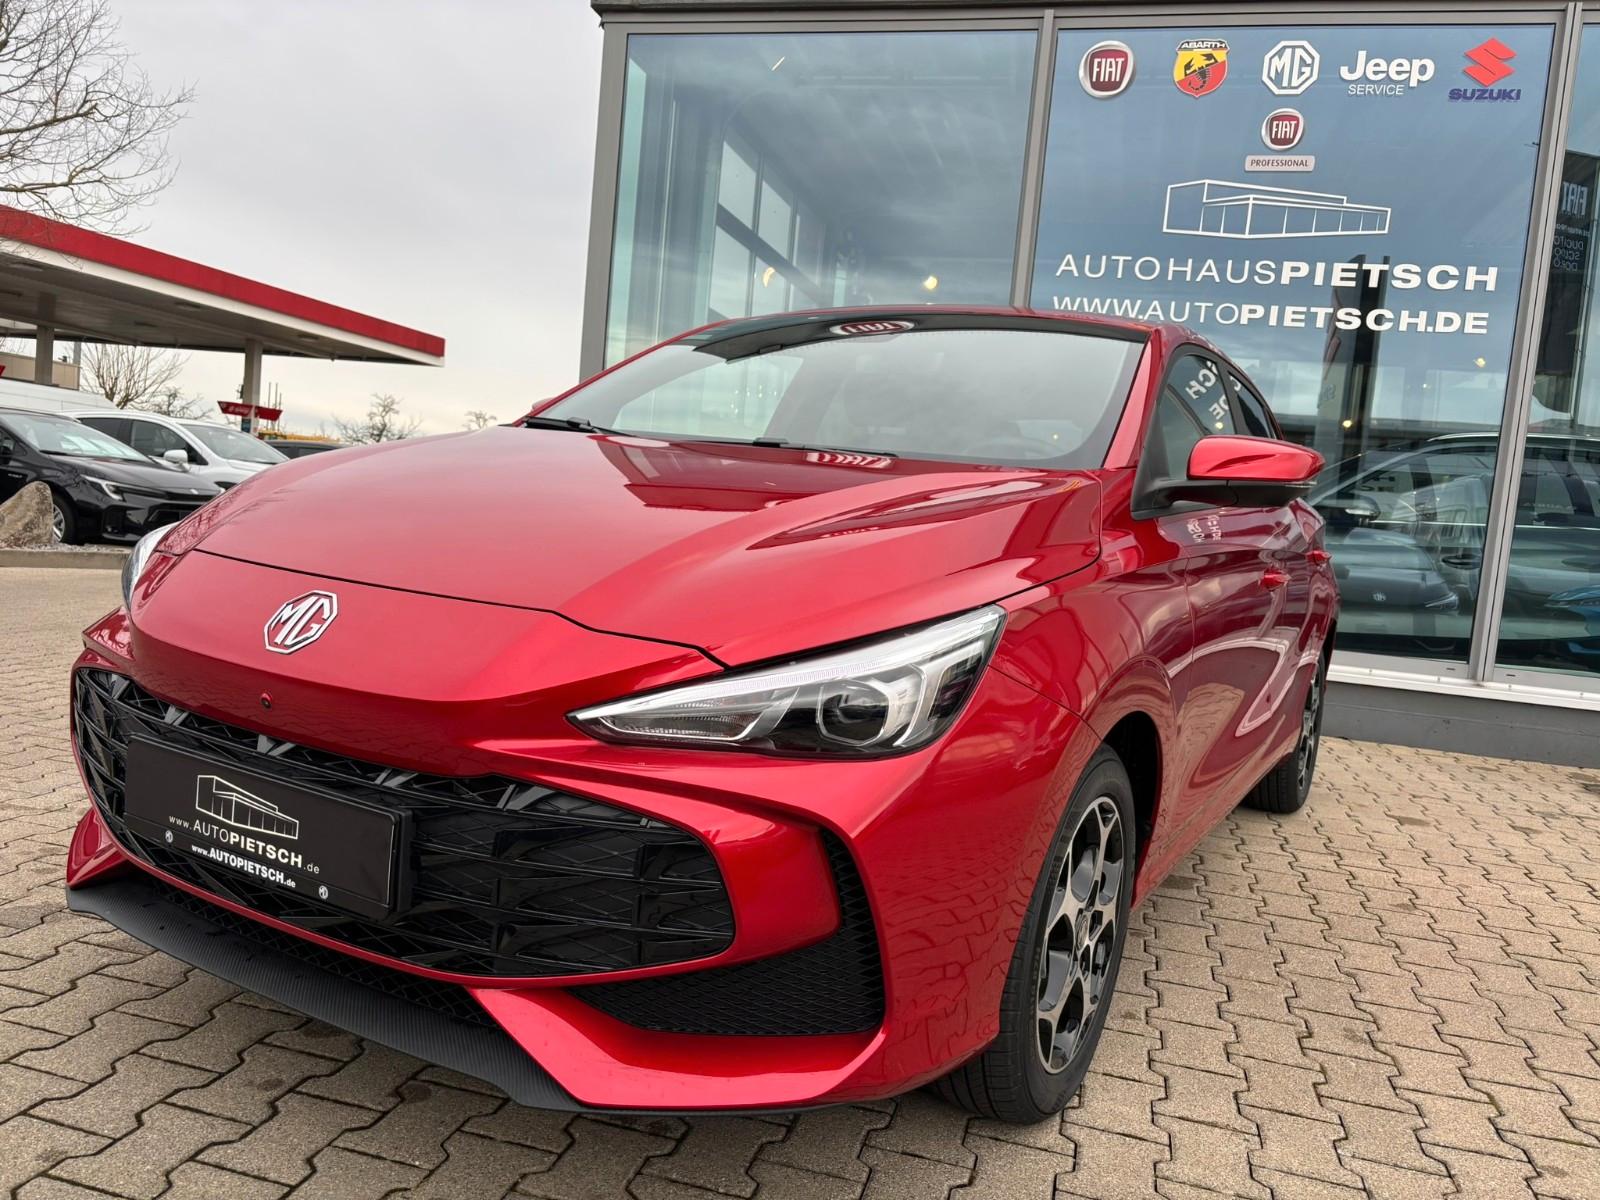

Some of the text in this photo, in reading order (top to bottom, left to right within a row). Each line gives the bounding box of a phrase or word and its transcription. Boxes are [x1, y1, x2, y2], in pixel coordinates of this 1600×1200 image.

[1180, 41, 1226, 50] ABARTH
[1092, 57, 1125, 83] FIAT
[1269, 45, 1314, 89] MG
[1340, 50, 1435, 87] Jeep
[1348, 84, 1405, 96] SERVICE
[1448, 88, 1522, 101] SUZUKI
[1271, 120, 1298, 140] FIAT
[1250, 159, 1309, 168] PROFESSIONAL
[1053, 295, 1490, 334] WWW.AUTOPIETSCH.DE
[269, 594, 332, 647] MG
[191, 844, 296, 888] www.AUTOPIETSCH.de
